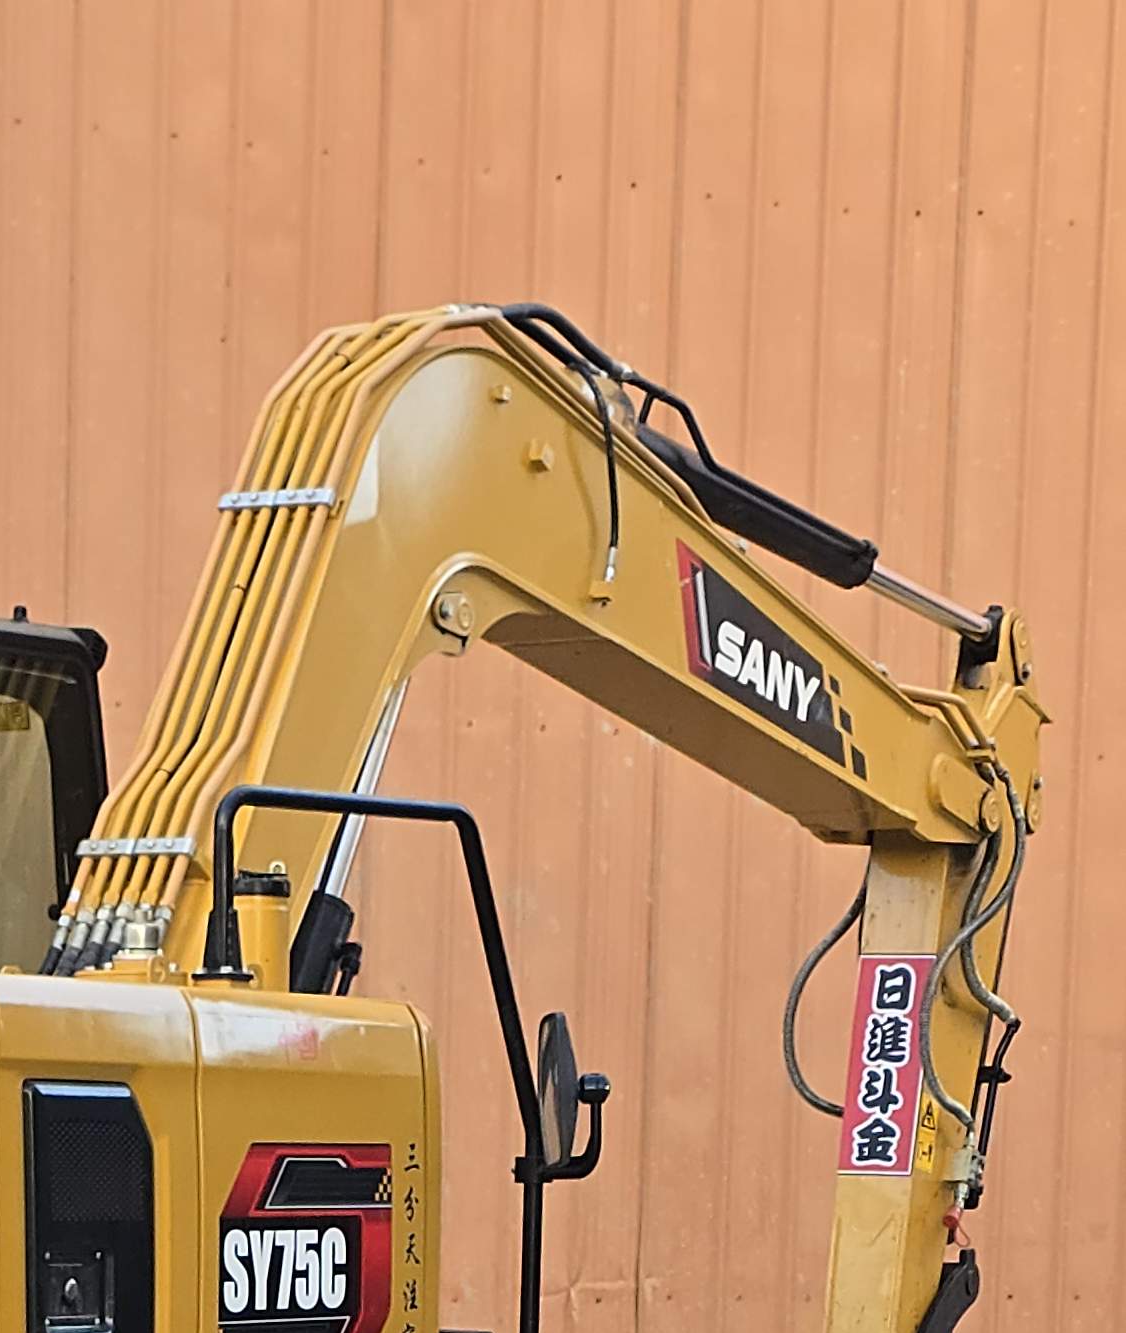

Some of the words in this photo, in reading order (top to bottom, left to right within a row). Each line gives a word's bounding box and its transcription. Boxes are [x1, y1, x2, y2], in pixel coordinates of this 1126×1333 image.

[715, 620, 821, 722] SANY
[854, 966, 914, 1163] 日進斗金
[223, 1226, 347, 1313] SY75C
